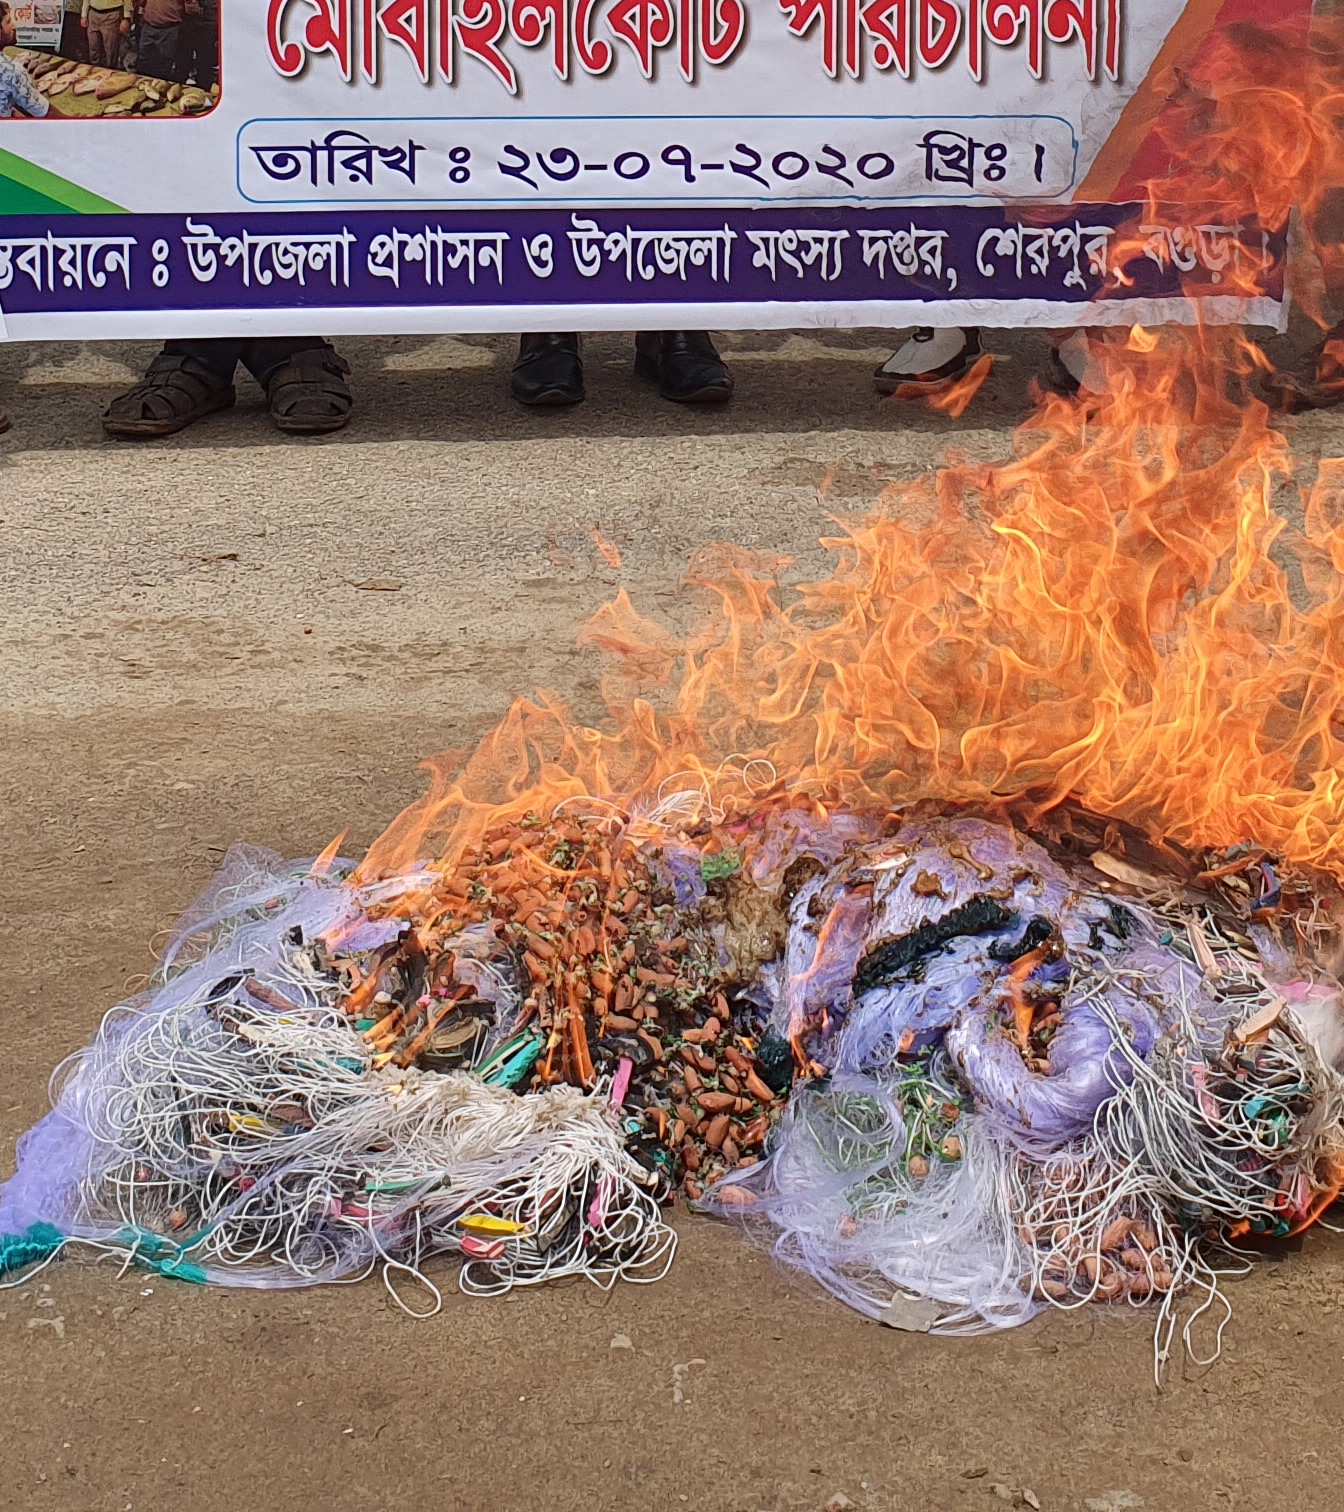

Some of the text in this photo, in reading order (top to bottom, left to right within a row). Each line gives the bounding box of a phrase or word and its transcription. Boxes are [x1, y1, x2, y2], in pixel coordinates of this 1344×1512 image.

[248, 130, 426, 188] তারিখ
[498, 143, 896, 189] ২৩-০৭-২০২০
[181, 217, 357, 288] উপজেলা
[367, 224, 510, 286] প্রশাসন
[523, 237, 554, 282] ও
[566, 211, 738, 282] উপজেলা
[746, 226, 850, 282] মৎস্য
[859, 223, 958, 290] দপ্তর,
[1137, 219, 1246, 284] বগুড়া
